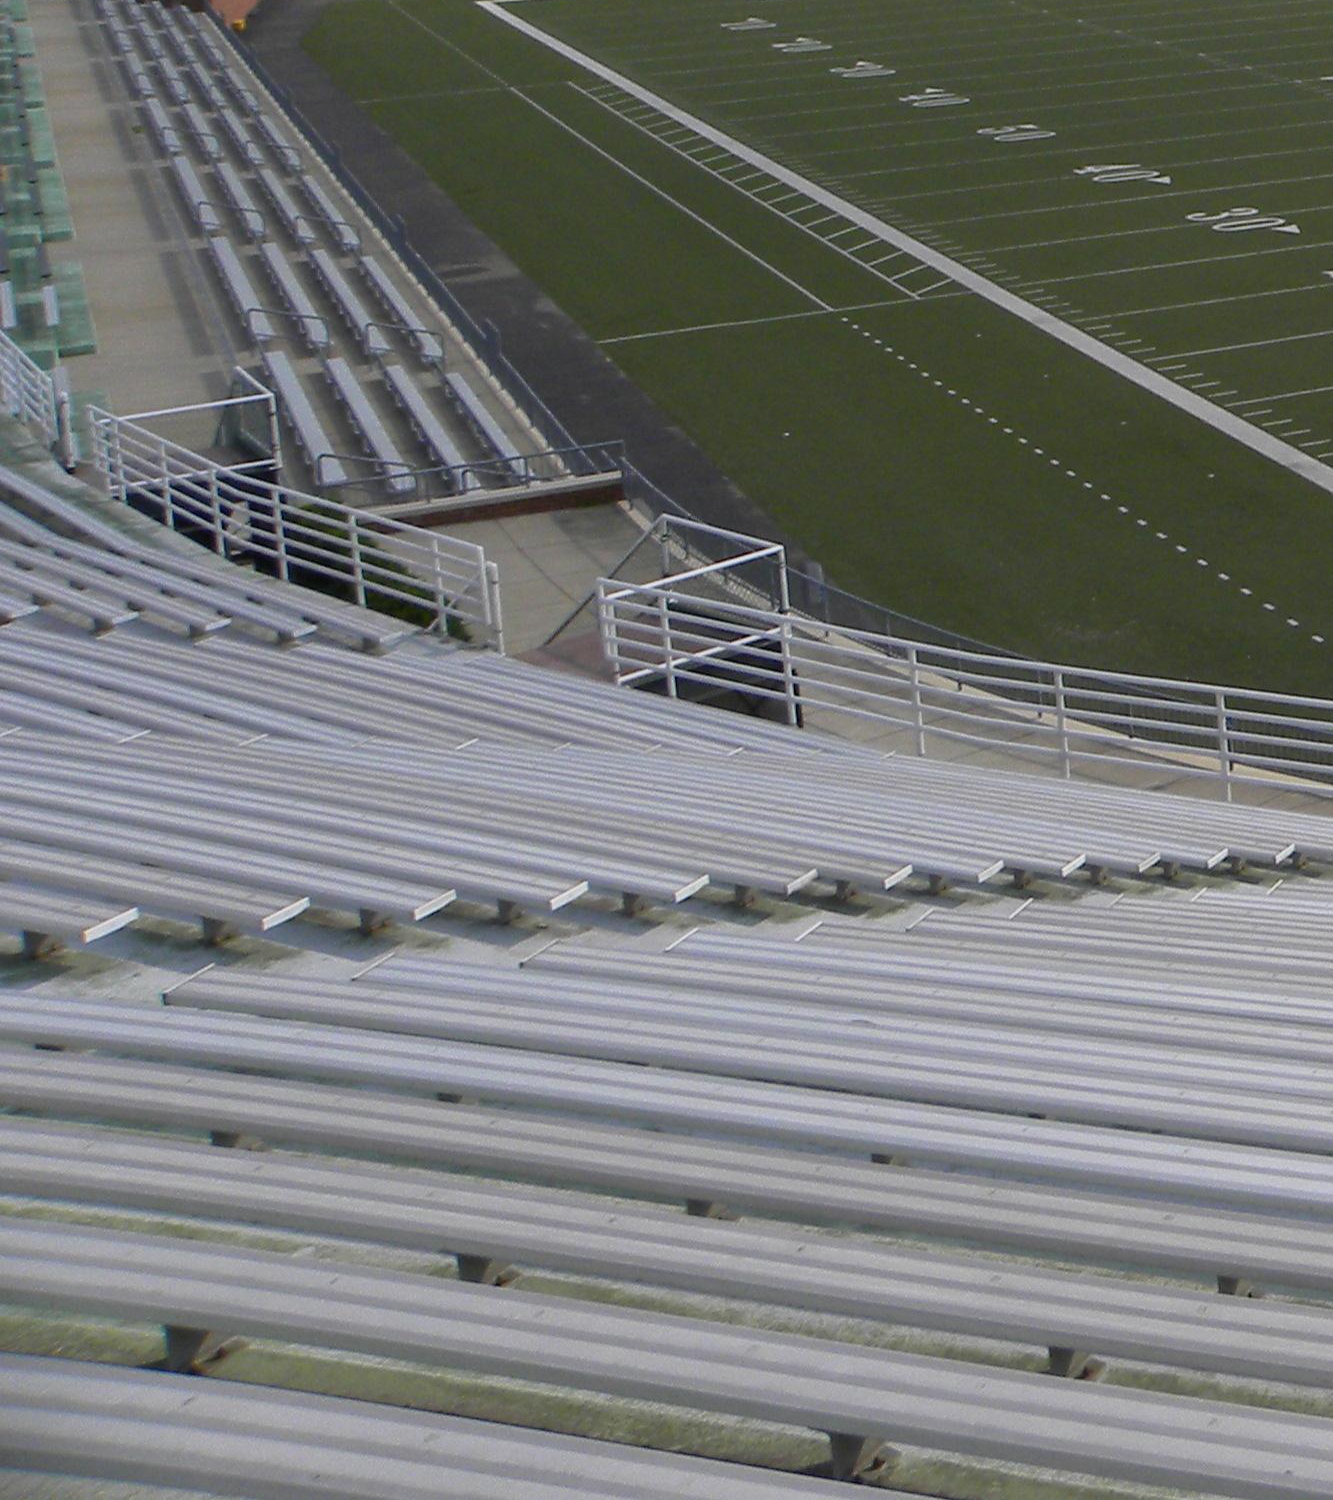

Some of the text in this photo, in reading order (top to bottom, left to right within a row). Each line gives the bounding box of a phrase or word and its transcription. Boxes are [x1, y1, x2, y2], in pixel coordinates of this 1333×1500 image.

[976, 124, 1057, 142] 50
[1072, 163, 1162, 184] 40
[1184, 207, 1288, 232] 30
